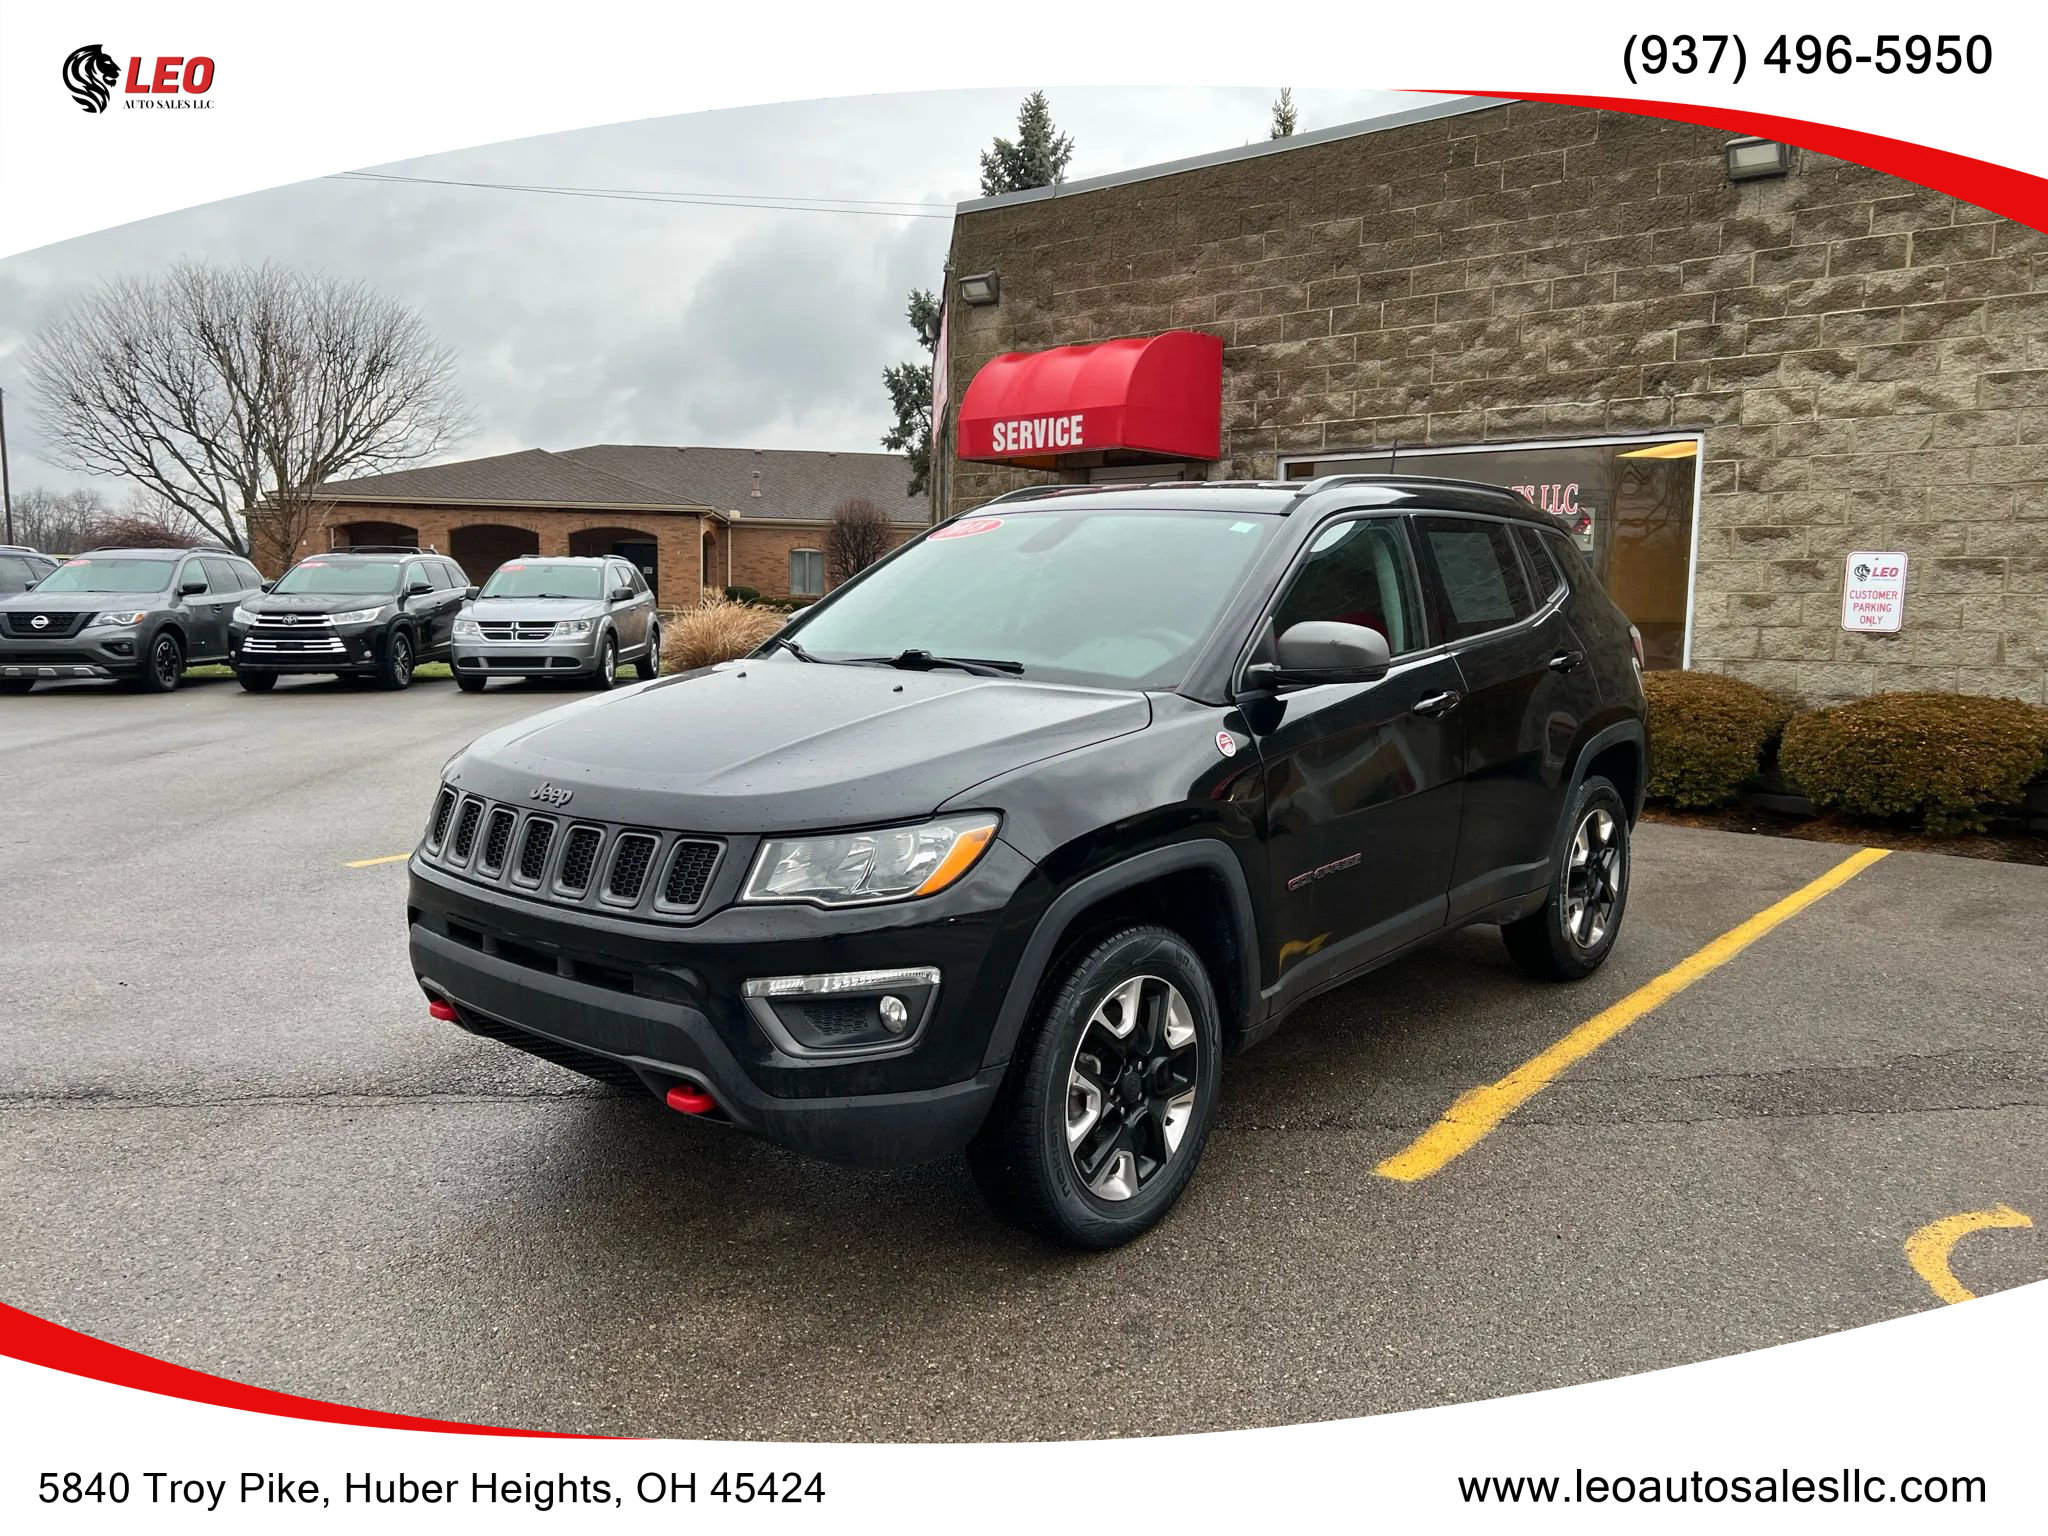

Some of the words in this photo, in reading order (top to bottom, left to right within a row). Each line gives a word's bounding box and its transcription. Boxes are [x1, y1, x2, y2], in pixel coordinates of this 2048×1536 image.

[992, 414, 1084, 452] SERVICE
[1540, 483, 1580, 515] LLC
[1871, 567, 1899, 578] LEO
[1849, 590, 1898, 600] CUSTOMER
[1853, 603, 1892, 613] PARKING
[1859, 615, 1883, 625] ONLY
[529, 781, 573, 808] Jeep
